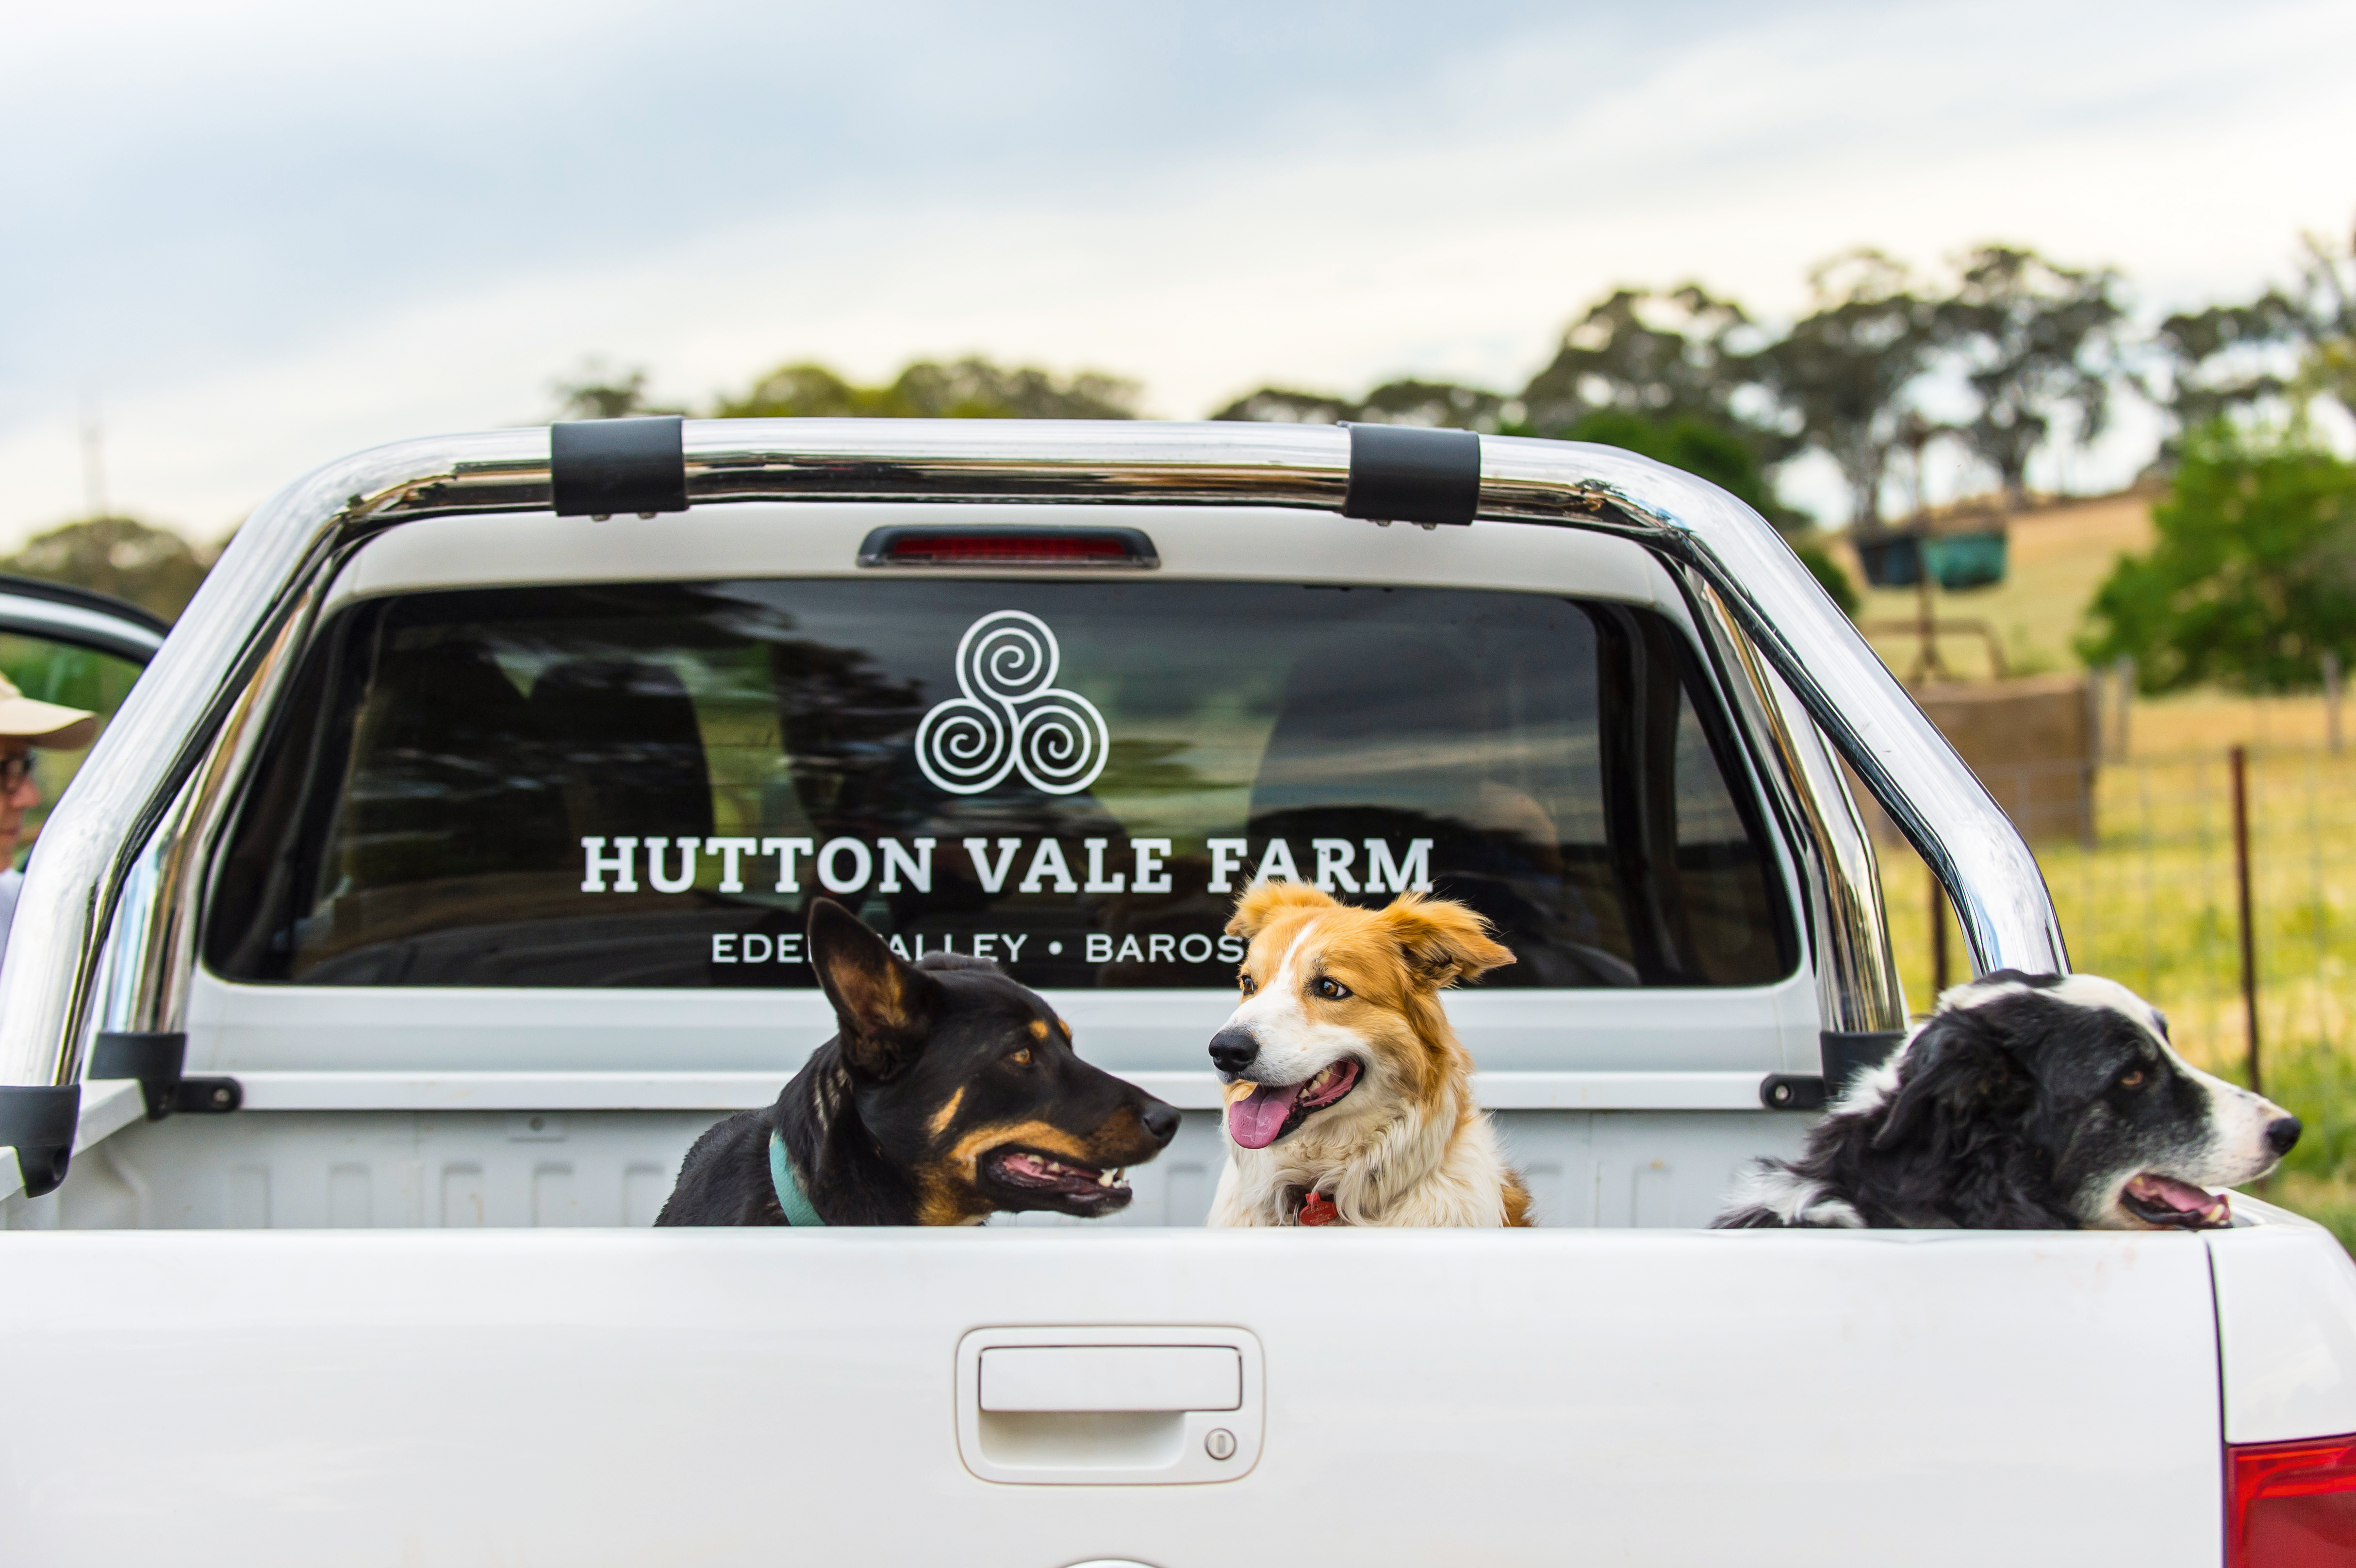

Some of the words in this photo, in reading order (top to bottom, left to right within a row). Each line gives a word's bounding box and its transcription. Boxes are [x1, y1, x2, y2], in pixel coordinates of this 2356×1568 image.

[581, 837, 936, 893] HUTTON
[963, 838, 1172, 893] VALE
[1207, 838, 1434, 893] FARM
[712, 933, 812, 963] EDE
[876, 933, 1028, 963] ALLEY
[1086, 933, 1252, 963] BAROS
